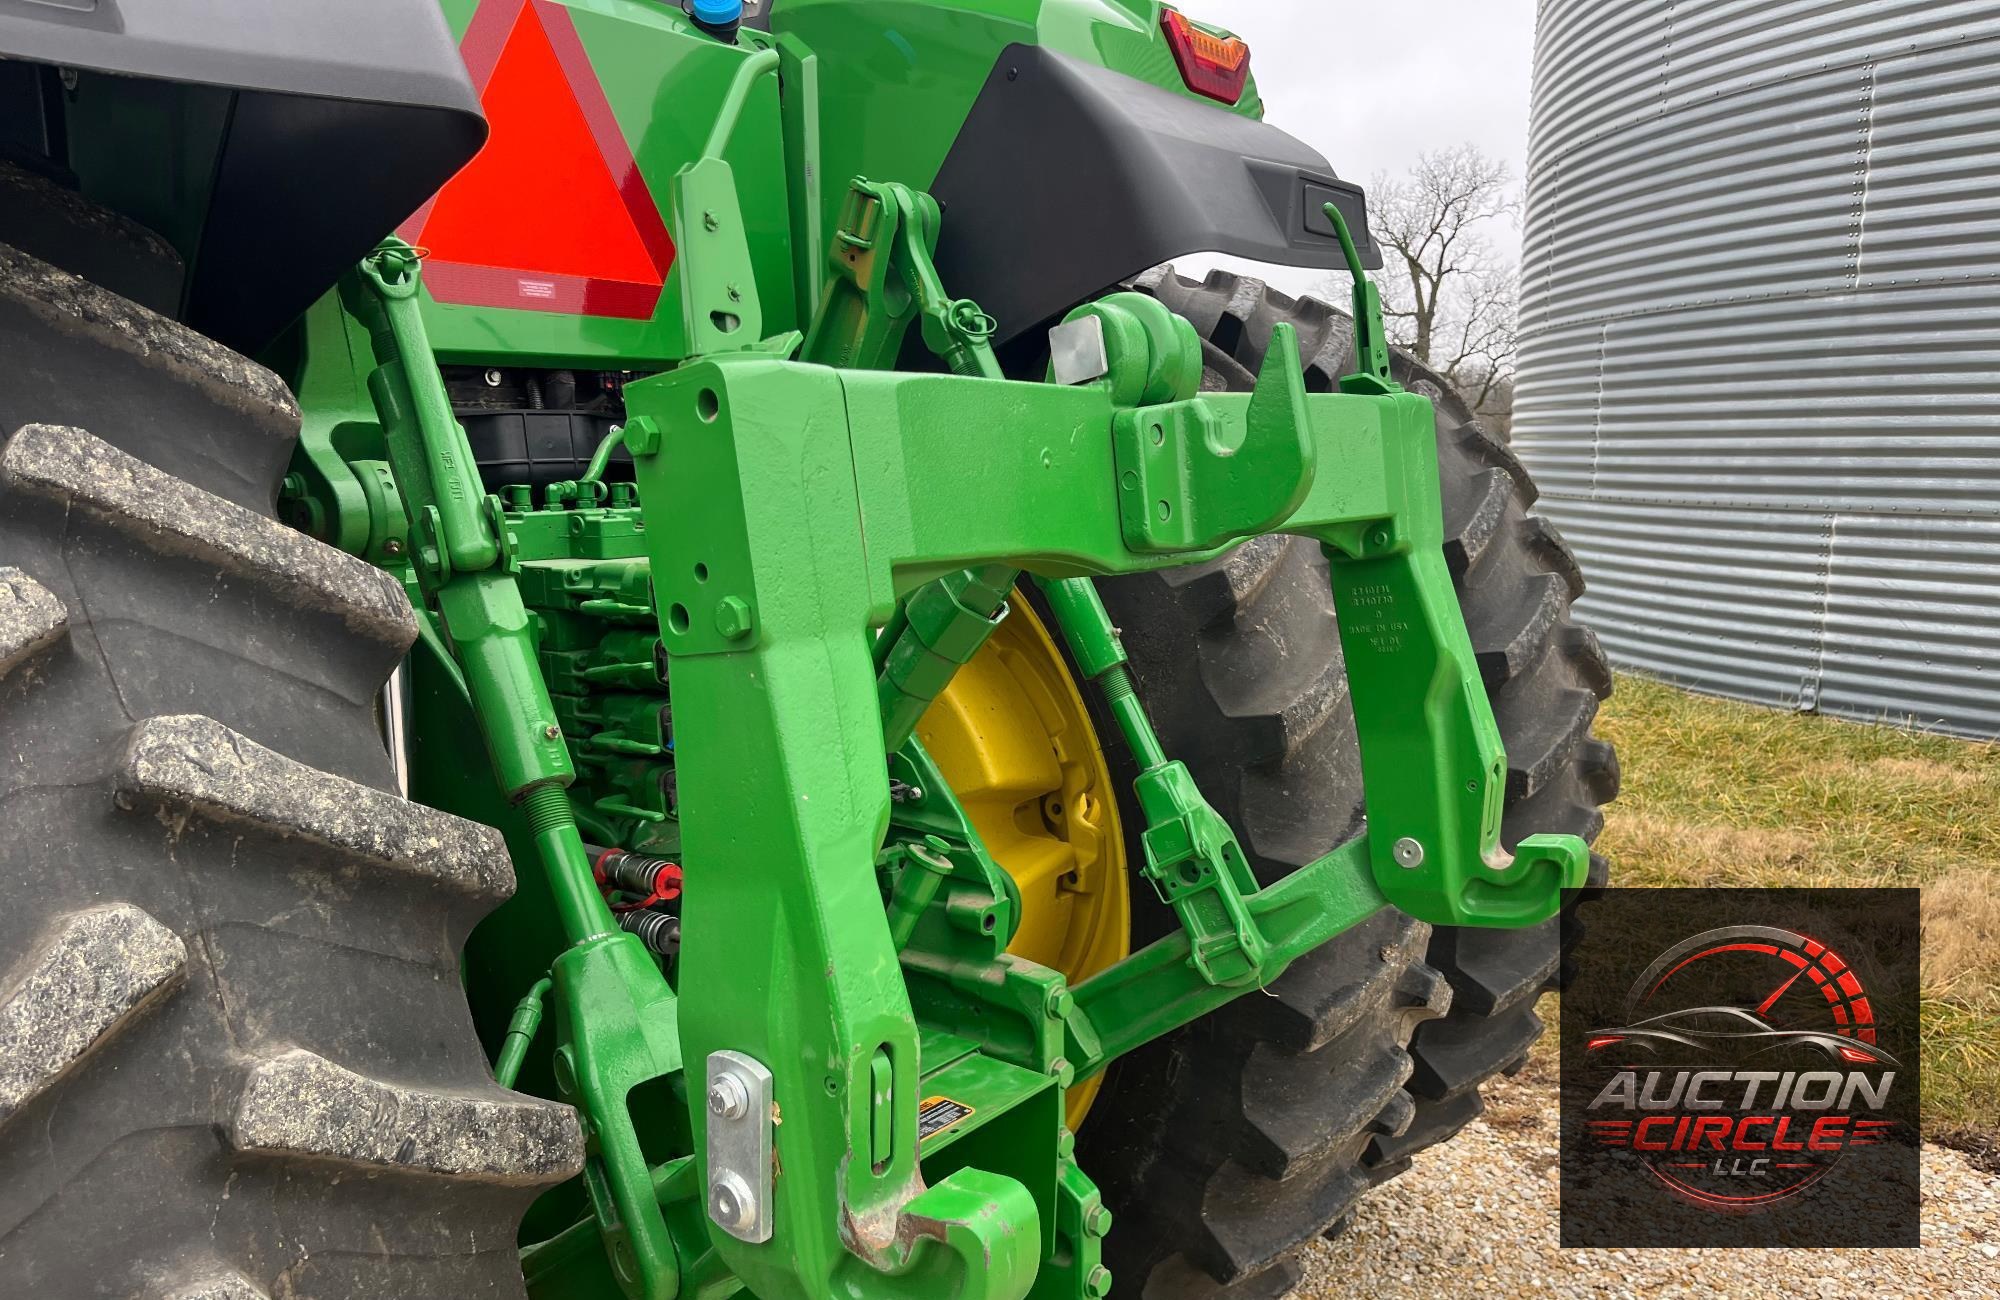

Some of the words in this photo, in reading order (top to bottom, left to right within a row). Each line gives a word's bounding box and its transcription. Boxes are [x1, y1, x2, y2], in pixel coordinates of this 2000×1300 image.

[1348, 624, 1371, 634] MADE
[1376, 624, 1386, 632] IN
[1390, 622, 1409, 632] USA
